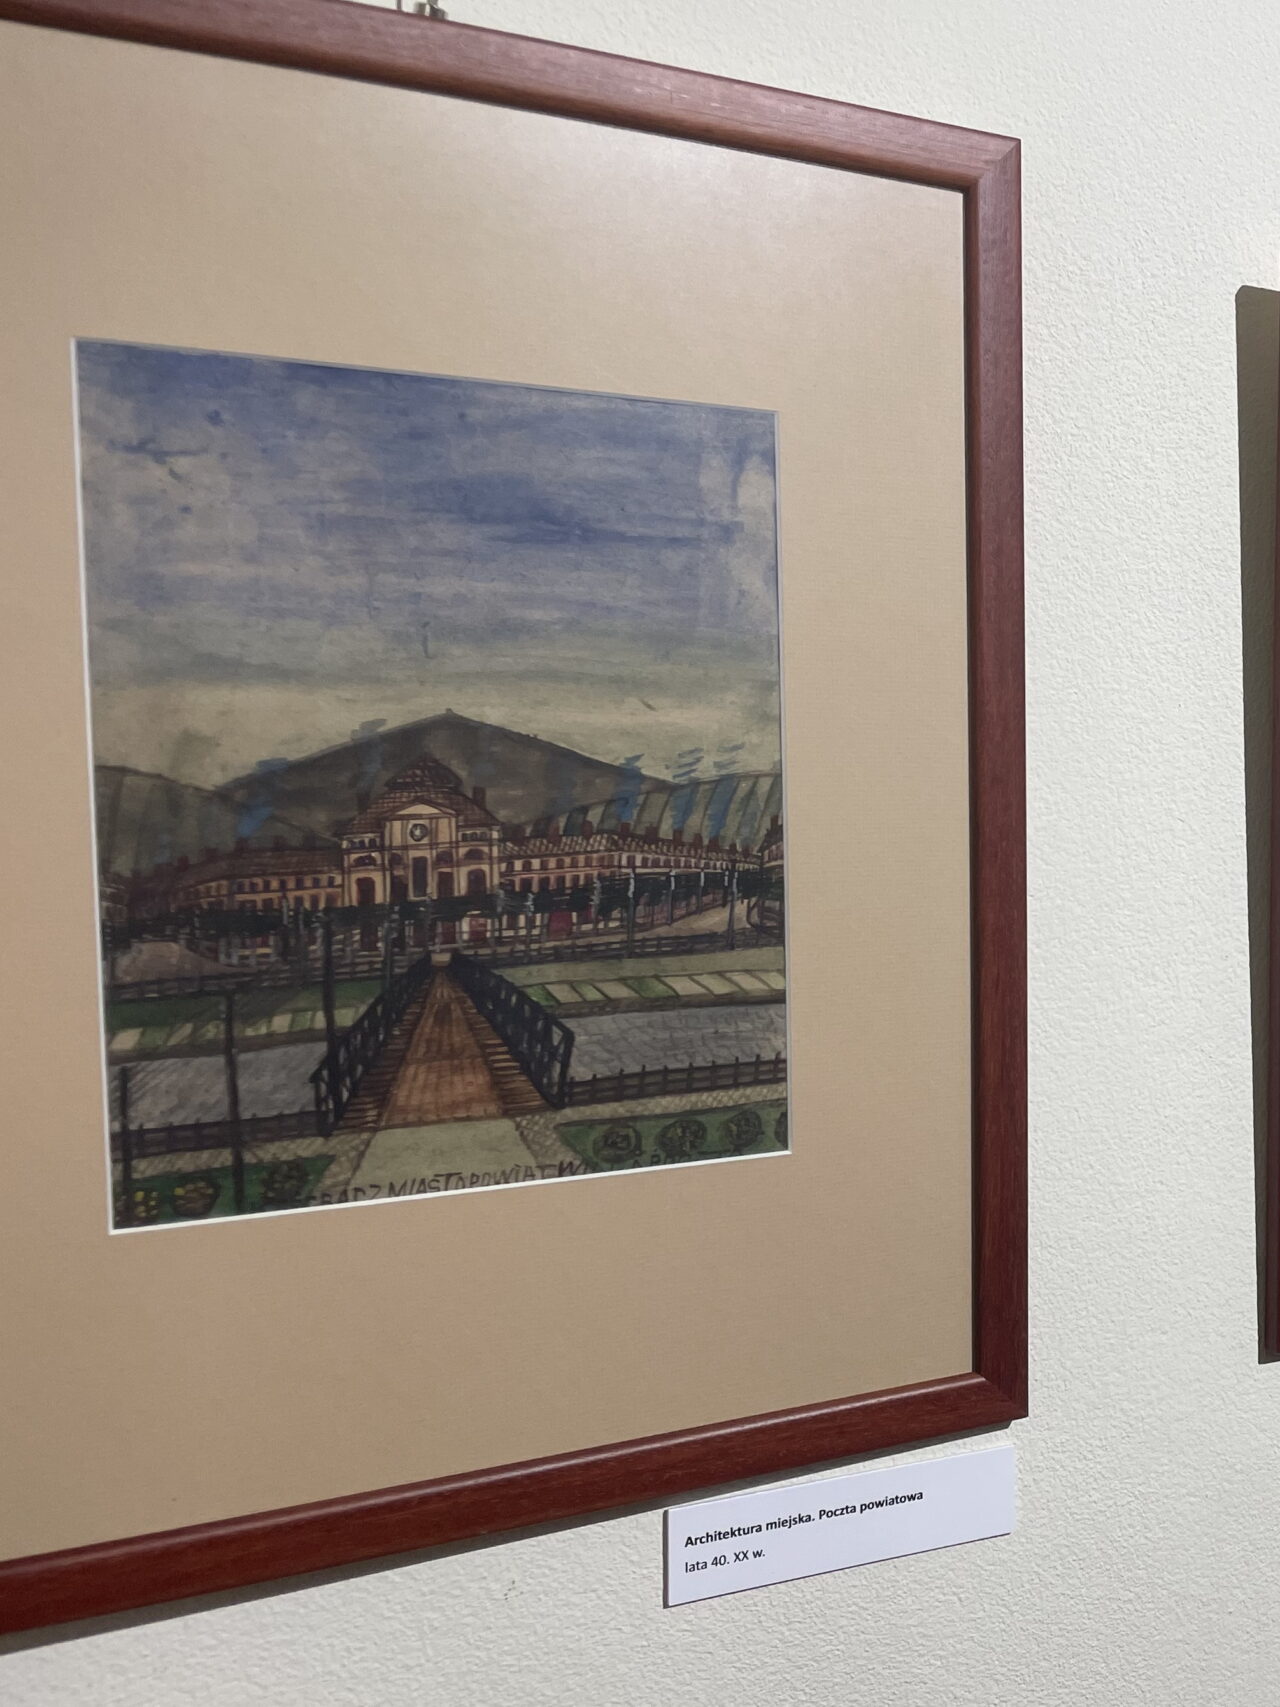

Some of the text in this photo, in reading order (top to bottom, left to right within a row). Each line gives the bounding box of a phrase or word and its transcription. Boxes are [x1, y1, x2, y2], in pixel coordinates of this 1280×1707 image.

[684, 1491, 924, 1548] Architektura miejska. Poczta powiatowa
[685, 1549, 766, 1573] lata 40. XX w.
